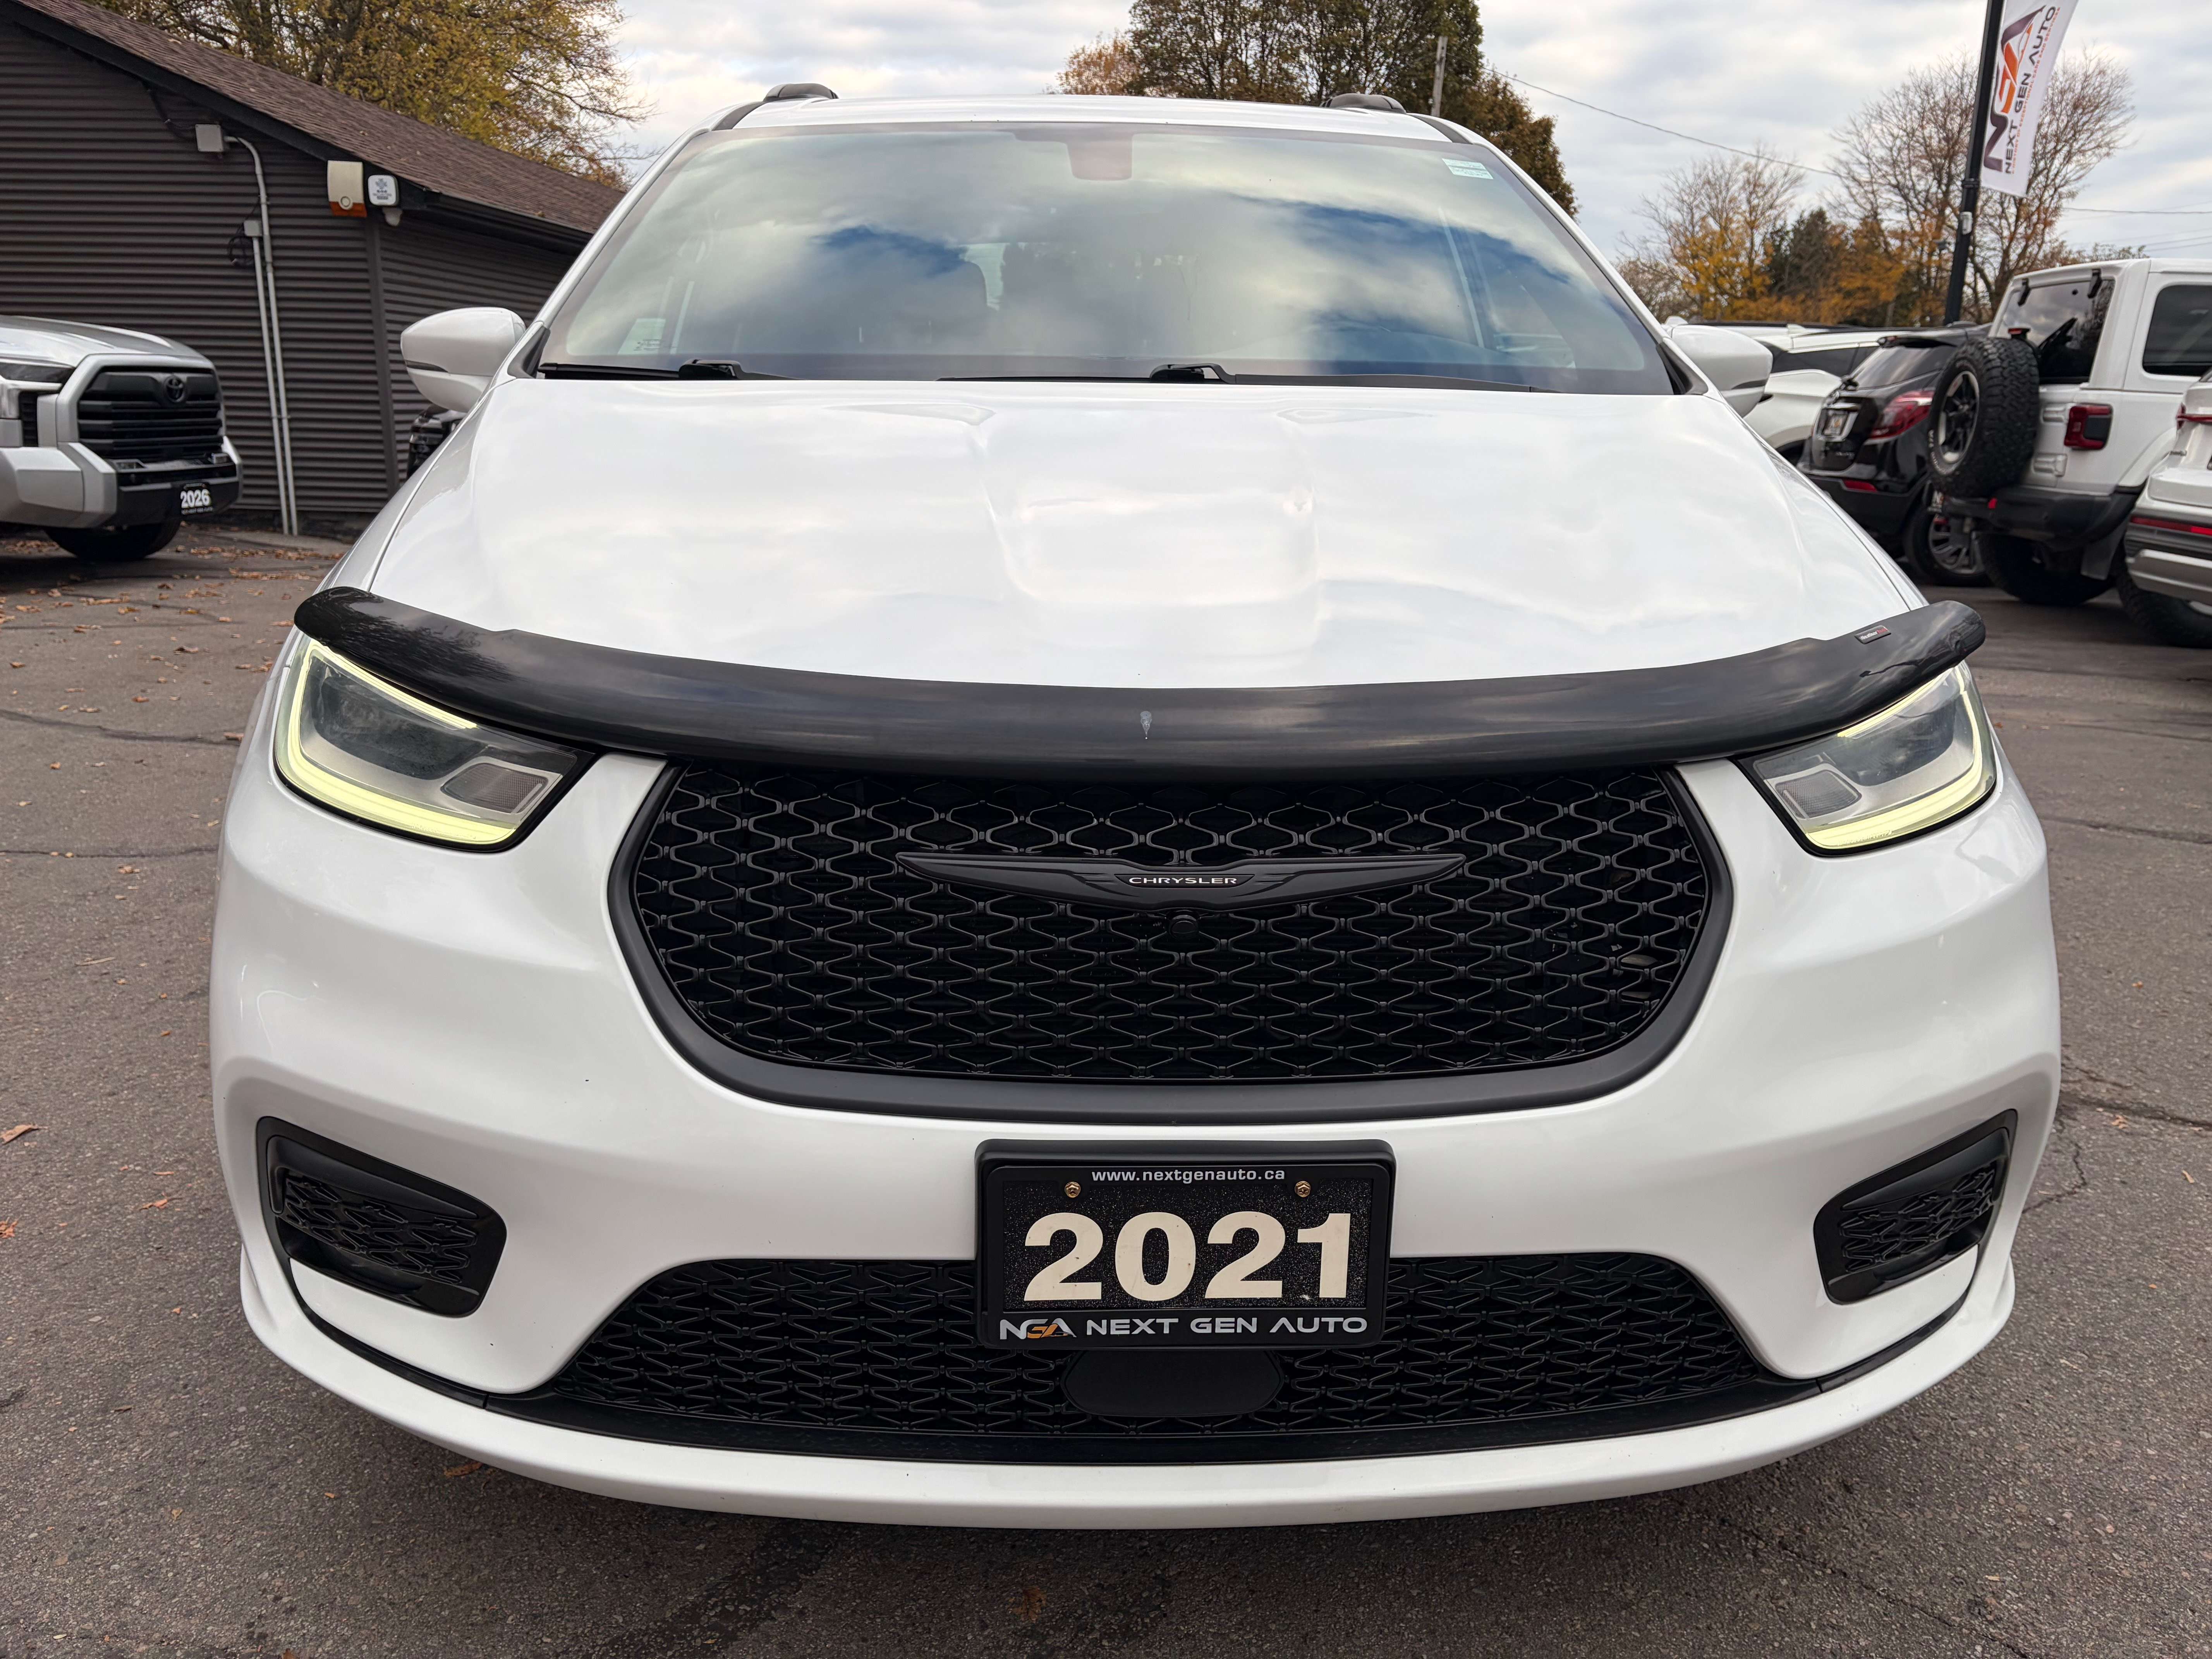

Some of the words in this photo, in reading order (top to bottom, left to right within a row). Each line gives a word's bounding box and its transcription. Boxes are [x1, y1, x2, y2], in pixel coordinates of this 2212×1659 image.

[2006, 119, 2018, 174] NEXT
[2014, 73, 2032, 113] GEN
[2029, 6, 2056, 65] AUTO
[180, 489, 211, 508] 2026
[1092, 1169, 1285, 1184] www.nextgenauto.ca
[1024, 1211, 1351, 1302] 2021
[1087, 1318, 1179, 1335] NEXT
[1190, 1317, 1257, 1333] GEN
[1269, 1317, 1367, 1333] AUTO
